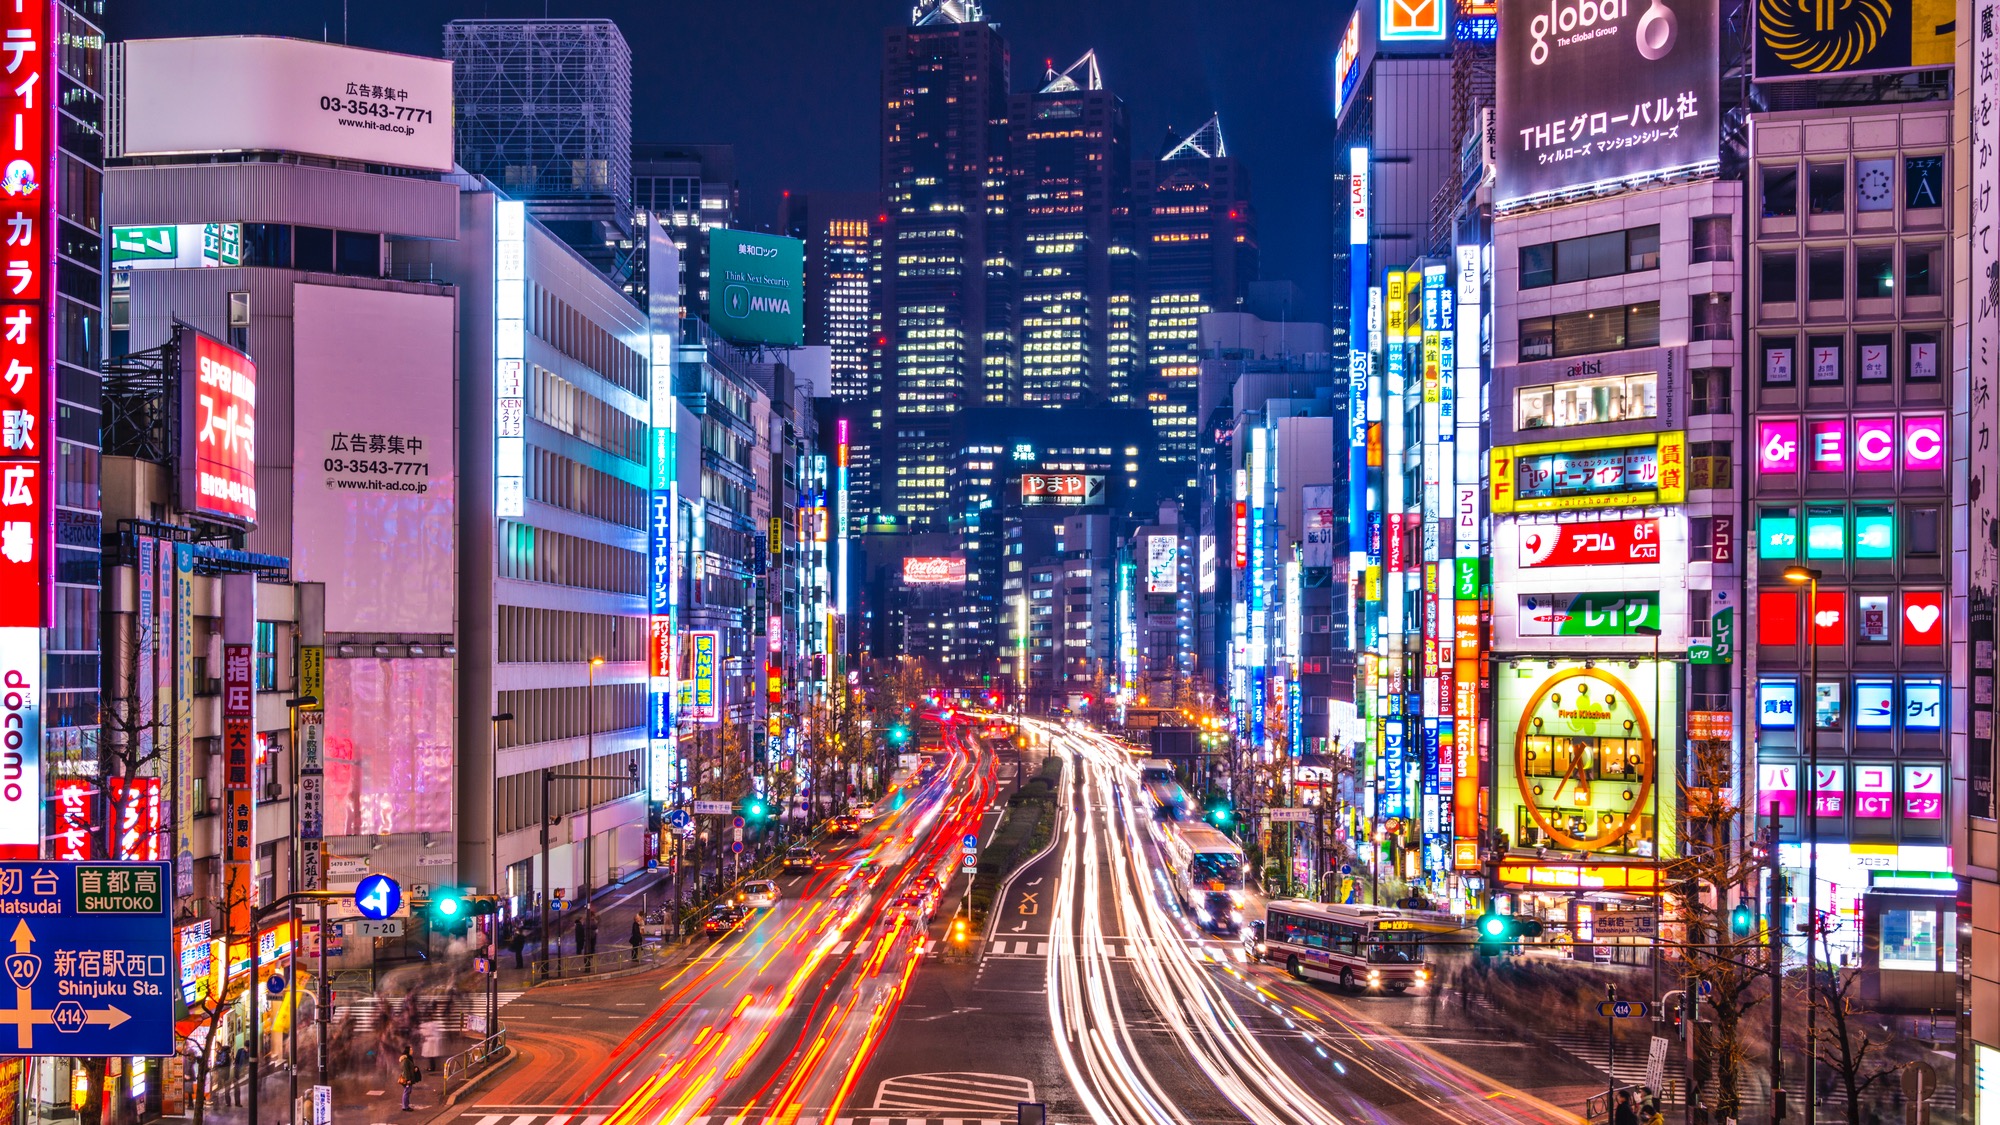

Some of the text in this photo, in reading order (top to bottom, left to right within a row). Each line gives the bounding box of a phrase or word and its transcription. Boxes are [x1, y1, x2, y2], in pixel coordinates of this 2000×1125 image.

[1530, 0, 1627, 65] global
[1557, 25, 1618, 47] The Global Group
[346, 82, 408, 102] 広告募集中
[320, 96, 432, 124] 03-3543-7771
[1520, 91, 1698, 150] THEグローバル社
[338, 119, 415, 136] www.hit-ad.co.jp
[1538, 125, 1679, 165] ウィルローズ マンションシリーズ
[1353, 175, 1362, 203] LABI
[1913, 177, 1936, 206] A
[738, 243, 778, 258] 美和ロック
[725, 271, 790, 288] Think Next Security
[1463, 249, 1475, 294] 村上ビル
[5, 211, 33, 396] カラオケ
[750, 295, 791, 315] MIWA
[1425, 334, 1437, 362] 麻雀
[1441, 336, 1452, 417] 秀研不動産
[500, 399, 522, 408] KEN
[1354, 398, 1366, 428] Your
[502, 408, 521, 436] パソコン スクール
[331, 432, 424, 456] 広告募集中
[1352, 428, 1366, 447] For
[1764, 433, 1796, 462] 6F
[324, 458, 430, 476] 03-3543-7771
[1555, 463, 1657, 487] エーアイアール
[1660, 444, 1682, 490] 賃貸
[1, 409, 35, 563] 歌広場
[337, 478, 428, 494] www.hit-ad.co.jp
[1028, 476, 1082, 493] やまや
[1494, 458, 1511, 501] 7F
[1461, 490, 1474, 527] アコム
[1572, 532, 1616, 553] アコム
[1633, 523, 1654, 541] 6F
[1716, 519, 1730, 560] アコム
[654, 496, 668, 608] コーユーコーポレーション
[1642, 548, 1657, 558] 入口
[1461, 562, 1474, 595] レイク
[1585, 599, 1648, 628] レイク
[1716, 618, 1729, 657] レイク
[1690, 650, 1709, 660] レイク
[227, 656, 249, 711] 指圧
[1558, 709, 1611, 720] First Kitchen
[1764, 699, 1793, 714] 賃貸
[1907, 700, 1939, 718] タイ
[4, 669, 30, 802] docomo
[227, 723, 249, 731] チケット
[1456, 681, 1469, 777] First Kitchen
[229, 731, 247, 783] 大黒屋
[1387, 735, 1402, 789] ソフマップ
[1426, 730, 1437, 770] ソフマップ
[1858, 798, 1891, 812] ICT
[1906, 798, 1939, 813] ビジ
[237, 803, 248, 848] 吉野家
[1857, 857, 1890, 866] プロミス
[80, 870, 157, 894] 首都高
[85, 896, 153, 910] SHUTOKO
[362, 922, 396, 934] 7-20
[1598, 915, 1651, 928] 西新宿一丁目
[13, 959, 34, 978] 20
[54, 949, 165, 977] 新宿駅西口
[58, 980, 163, 998] Shinjuku Sta.
[57, 1009, 82, 1025] 414
[1615, 1005, 1629, 1015] 414
